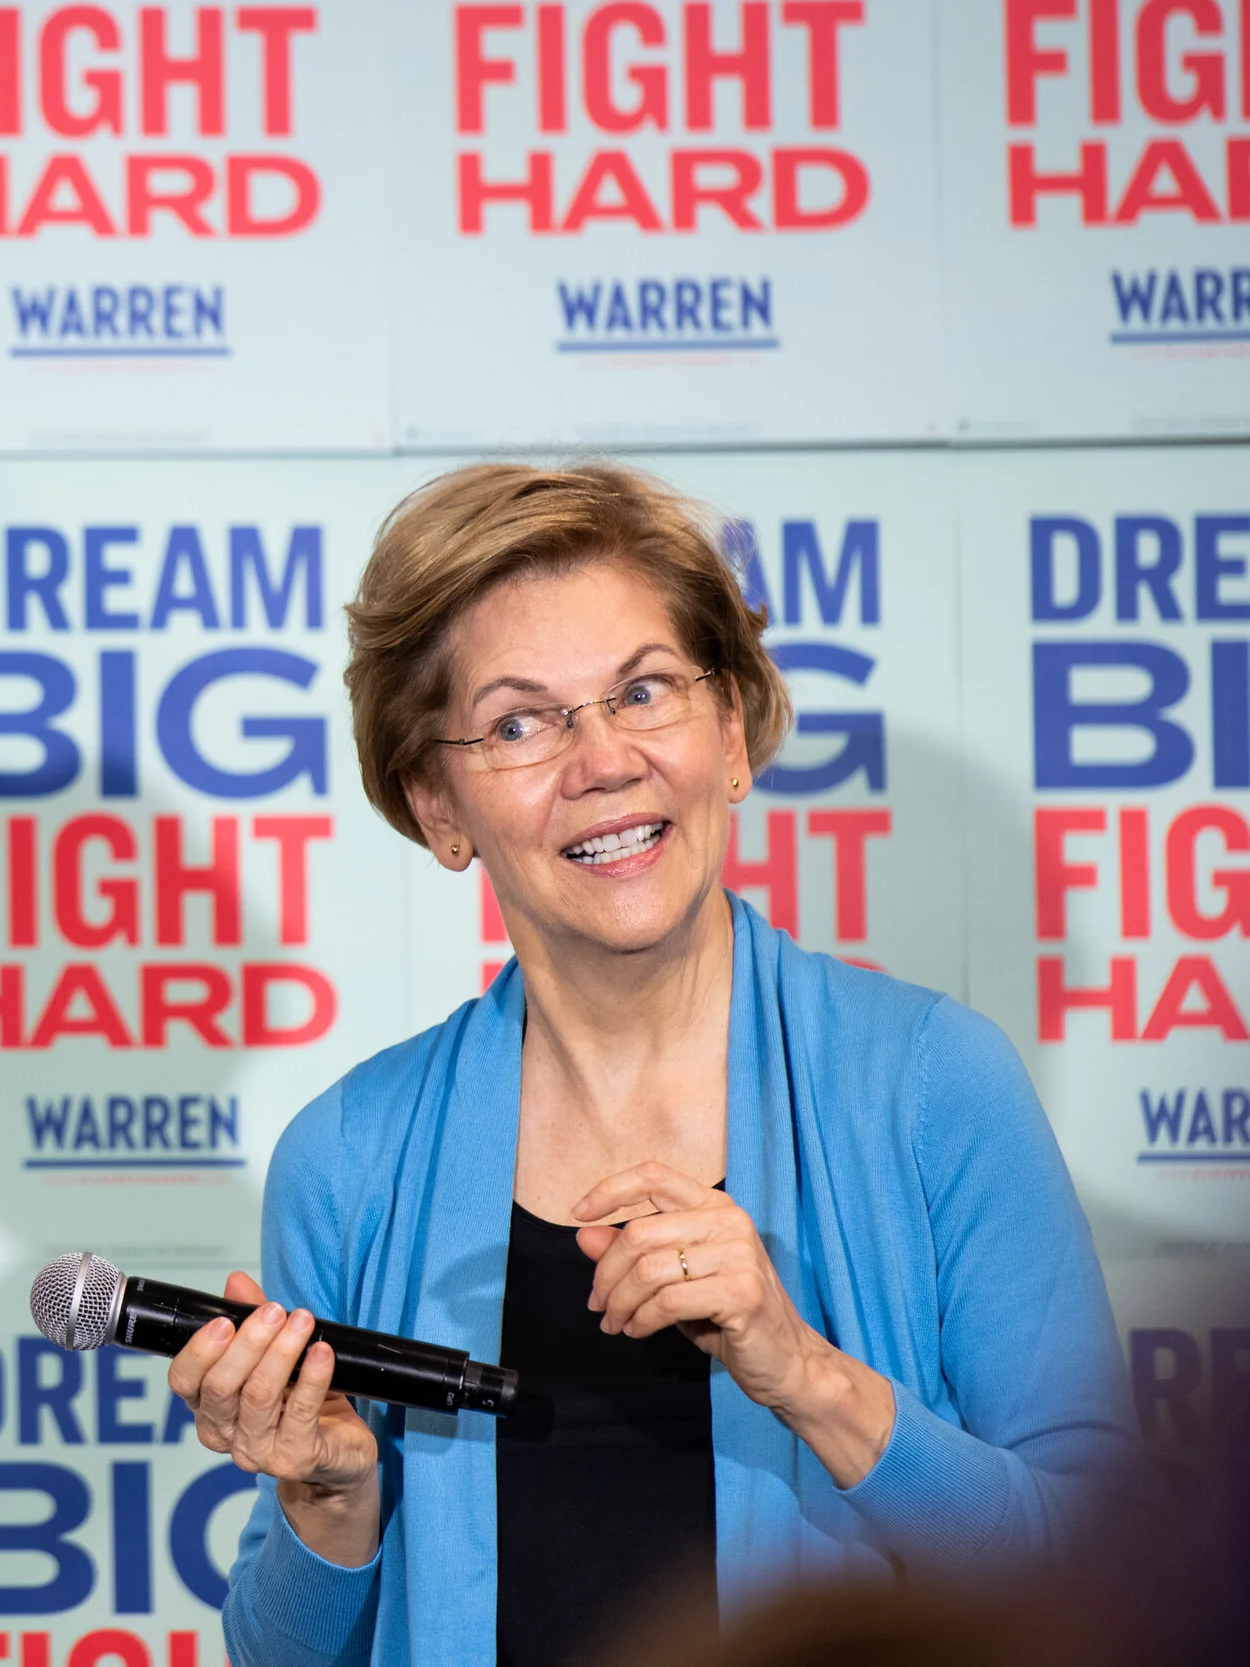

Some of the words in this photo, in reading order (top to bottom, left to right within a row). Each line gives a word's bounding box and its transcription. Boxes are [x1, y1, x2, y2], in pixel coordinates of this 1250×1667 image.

[453, 0, 866, 136] FIGHT
[1003, 0, 1250, 127] FIG
[456, 146, 871, 235] HARD
[1007, 136, 1250, 228] HA
[11, 284, 224, 338] WARREN
[557, 279, 773, 333] WARREN
[1029, 513, 1250, 623] DRE
[1031, 638, 1250, 791] BI
[1033, 804, 1250, 942] FIG
[1036, 954, 1250, 1043] HA
[24, 1096, 238, 1151] WARREN
[1139, 1088, 1250, 1146] WAR
[125, 1309, 138, 1344] SHURE
